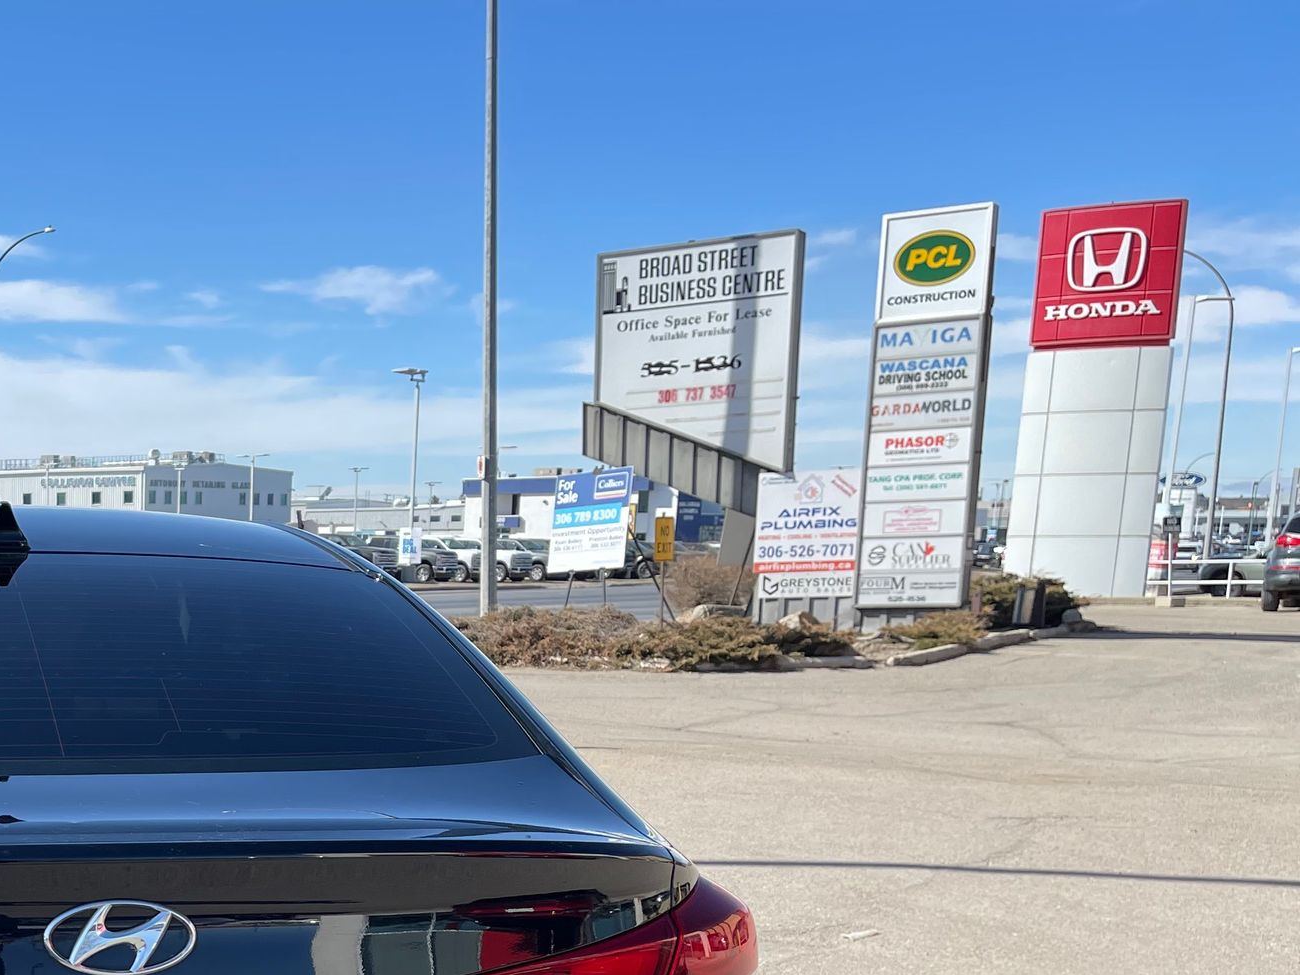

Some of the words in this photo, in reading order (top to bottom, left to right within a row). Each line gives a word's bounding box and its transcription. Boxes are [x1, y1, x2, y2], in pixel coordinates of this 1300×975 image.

[639, 253, 693, 279] BROAD
[698, 245, 758, 273] STREET
[905, 245, 963, 272] PCL
[638, 277, 717, 305] BUSINESS
[722, 269, 785, 296] CENTRE
[887, 289, 976, 306] CONSTRUCTION
[1044, 299, 1161, 321] HONDA
[617, 318, 659, 332] Office
[664, 315, 701, 330] Space
[707, 311, 729, 323] For
[735, 307, 773, 321] Lease
[648, 331, 689, 343] Available
[691, 326, 737, 339] Furnished
[880, 357, 968, 373] WASCANA
[878, 372, 921, 385] DRIVING
[924, 369, 968, 382] SCHOOL
[657, 388, 678, 404] 306
[685, 386, 704, 401] 737
[710, 384, 737, 400] 3547
[885, 435, 946, 449] PHASOR
[558, 480, 576, 491] For
[598, 479, 625, 489] Colliers
[557, 491, 579, 504] Sale
[555, 512, 573, 525] 306
[574, 510, 592, 522] 789
[593, 508, 618, 521] 8300
[778, 507, 841, 518] AIRFIX
[660, 526, 670, 537] NO
[760, 518, 857, 531] PLUMBING
[657, 542, 672, 553] EXIT
[759, 543, 854, 558] 306-526-7071
[758, 562, 852, 573] airfixplumbing.ca
[780, 577, 852, 588] GREYSTONE
